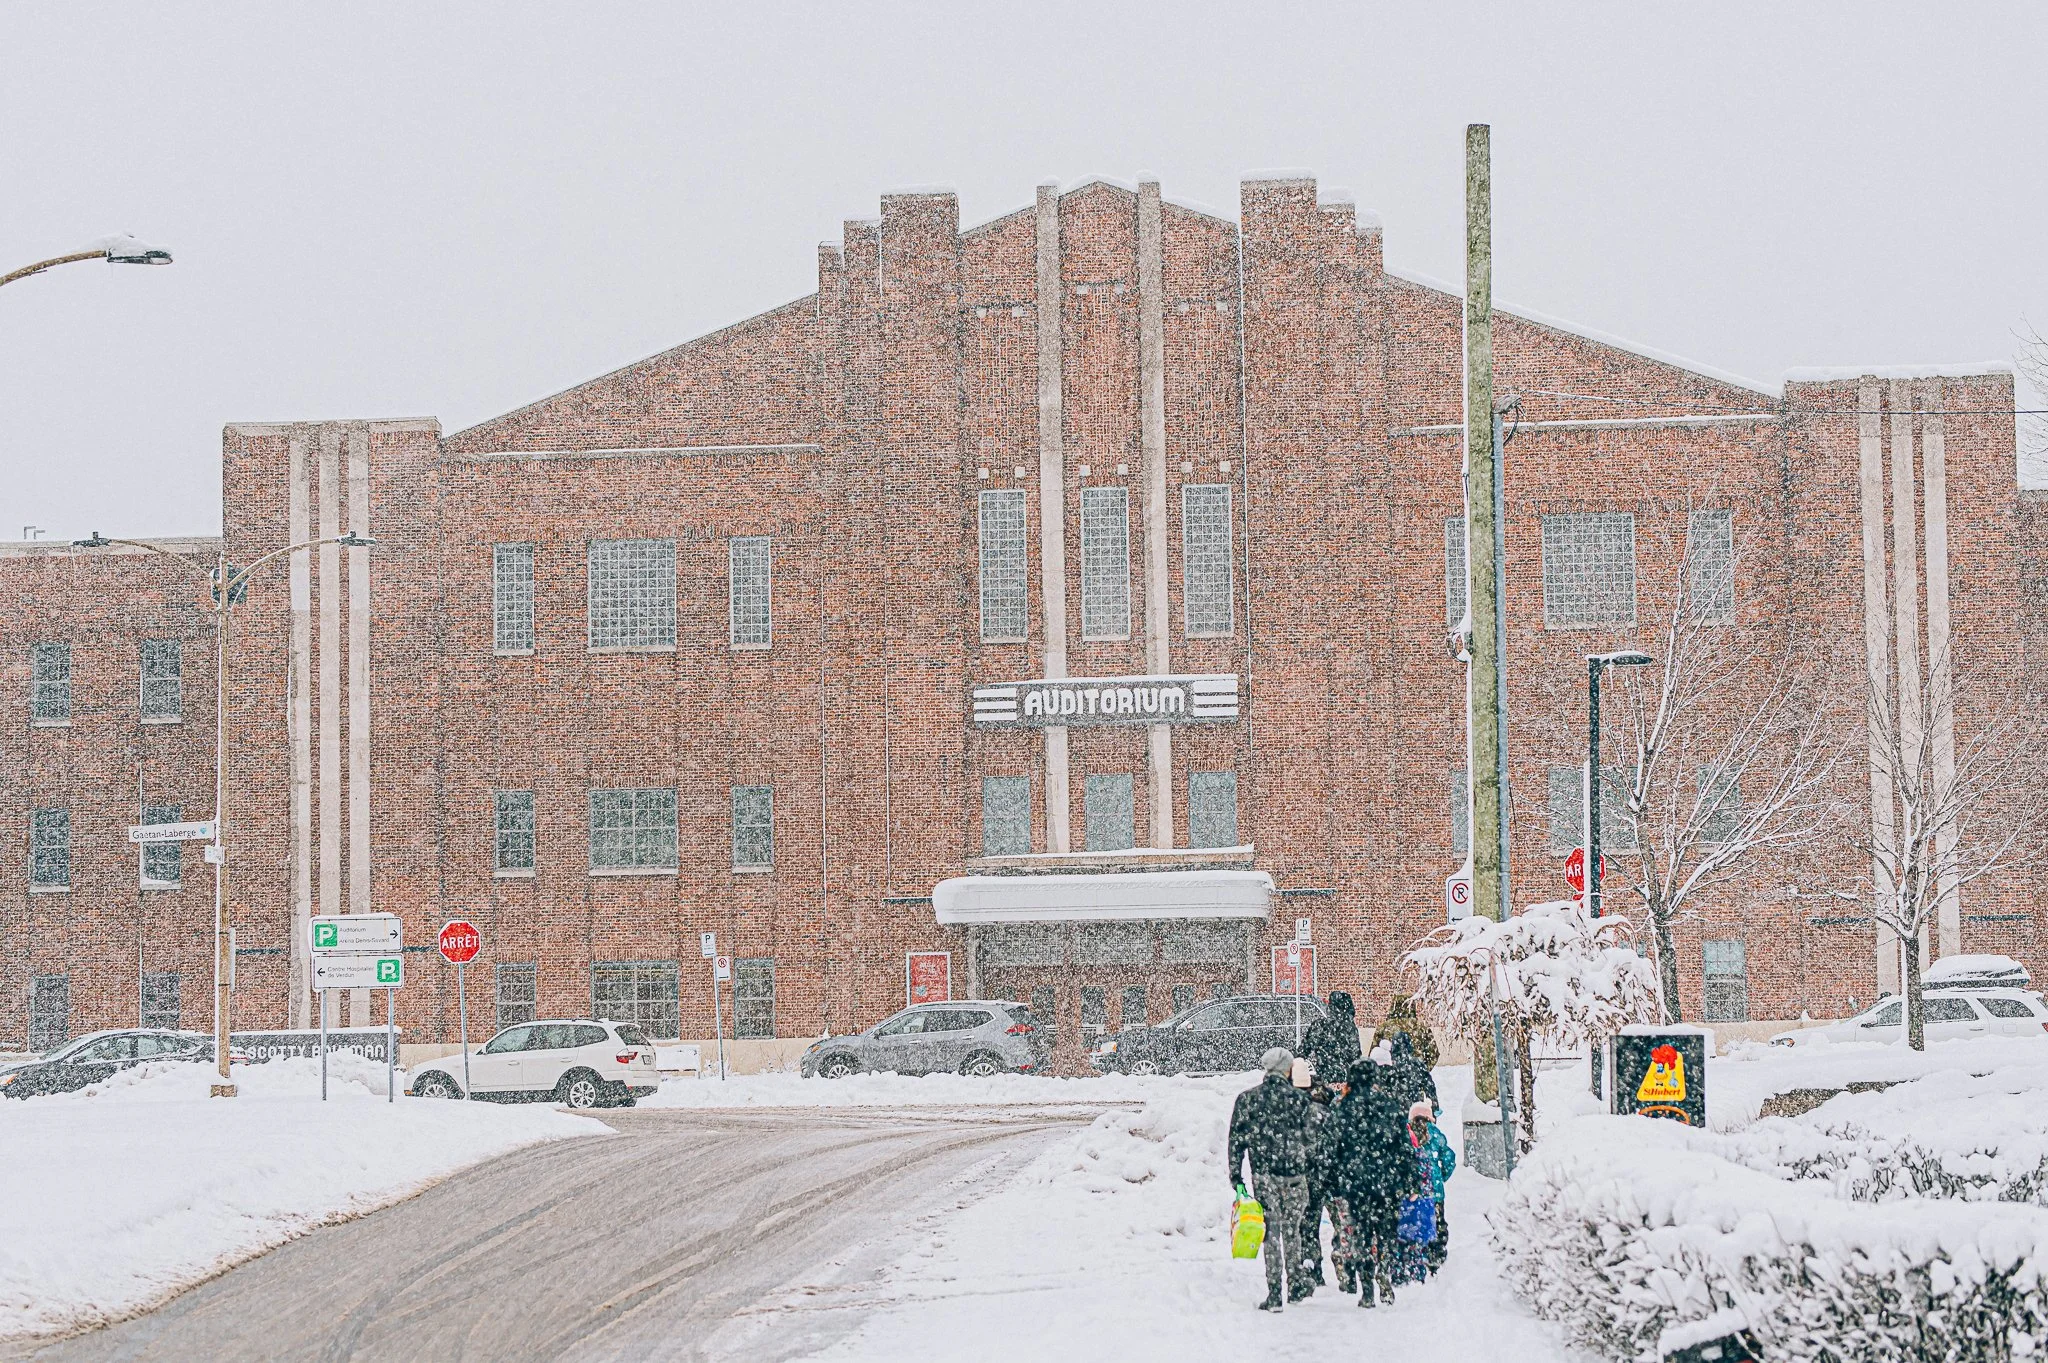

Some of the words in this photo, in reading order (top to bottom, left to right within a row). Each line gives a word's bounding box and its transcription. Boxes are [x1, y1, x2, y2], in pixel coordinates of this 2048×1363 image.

[1024, 686, 1185, 716] AUDITORIUM
[318, 926, 334, 945] P
[441, 933, 478, 949] ARRÊT
[380, 961, 396, 980] P
[248, 1045, 306, 1060] SCOTTY
